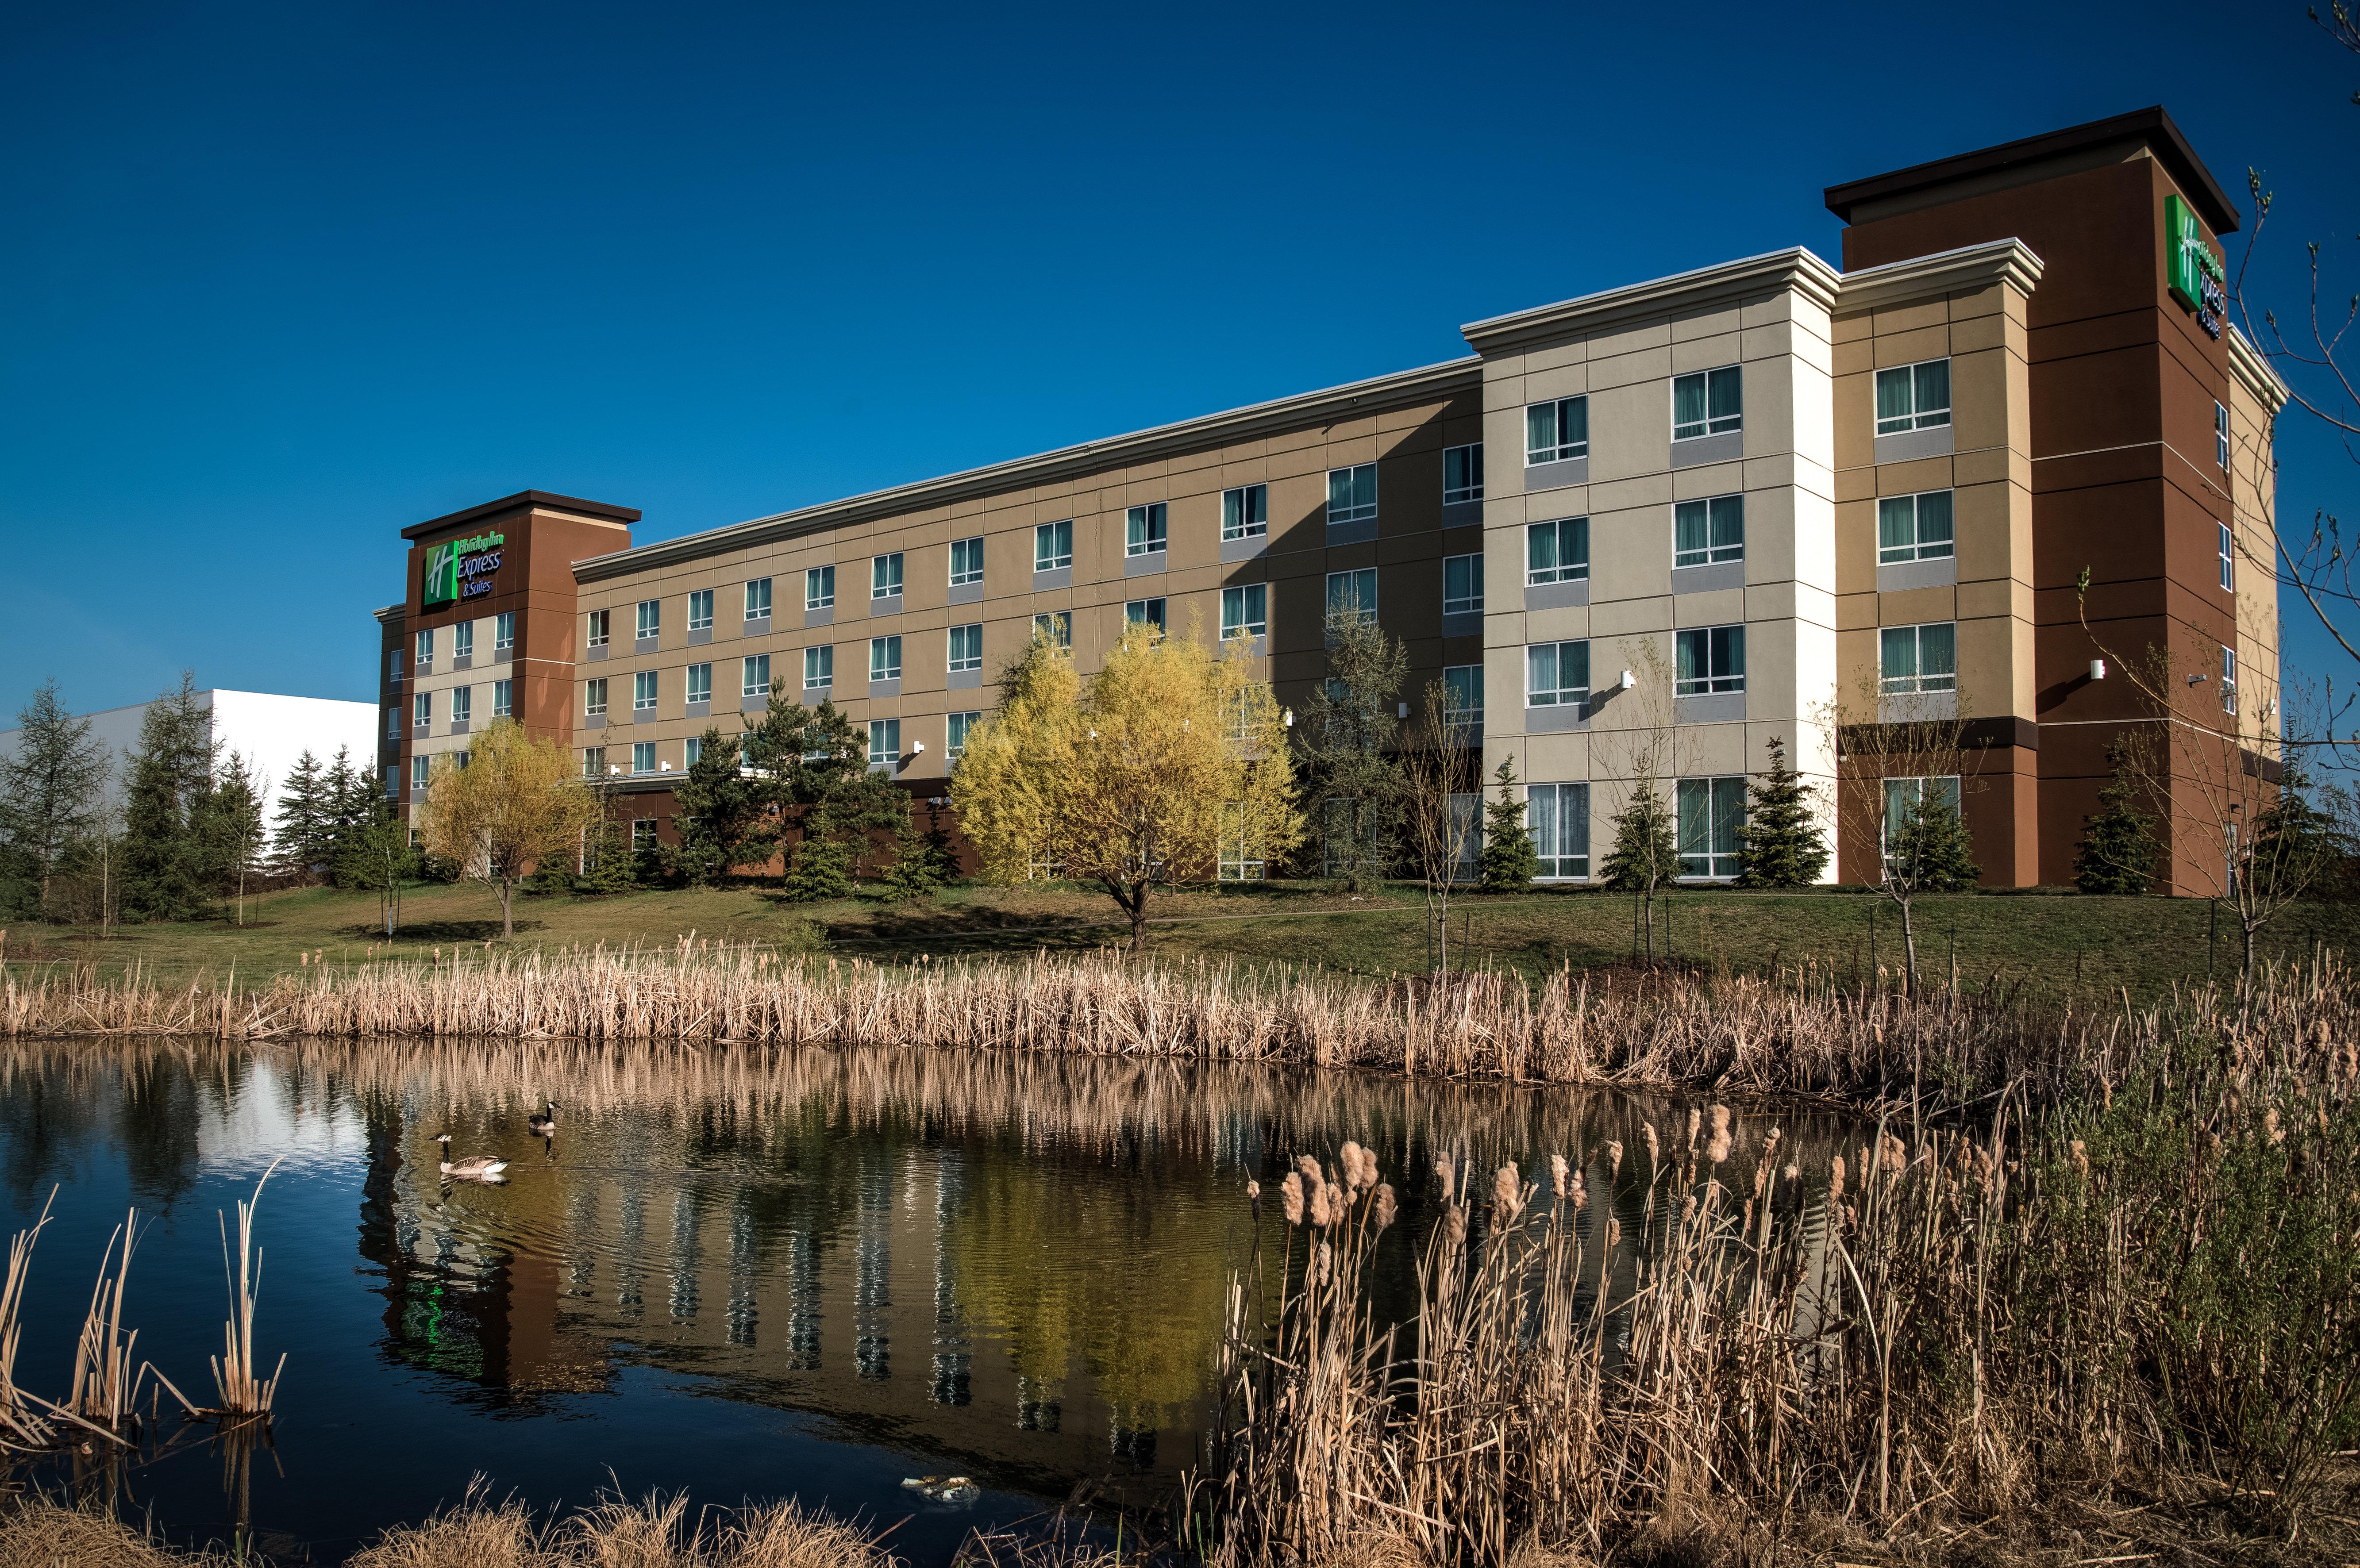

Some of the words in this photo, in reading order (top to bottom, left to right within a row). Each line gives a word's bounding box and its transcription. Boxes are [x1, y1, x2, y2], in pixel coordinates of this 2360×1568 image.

[2200, 272, 2225, 315] xpress
[458, 535, 489, 555] Holiday
[489, 531, 504, 546] Inn
[457, 552, 502, 581] Express
[463, 584, 469, 596] &
[470, 580, 493, 595] Suites
